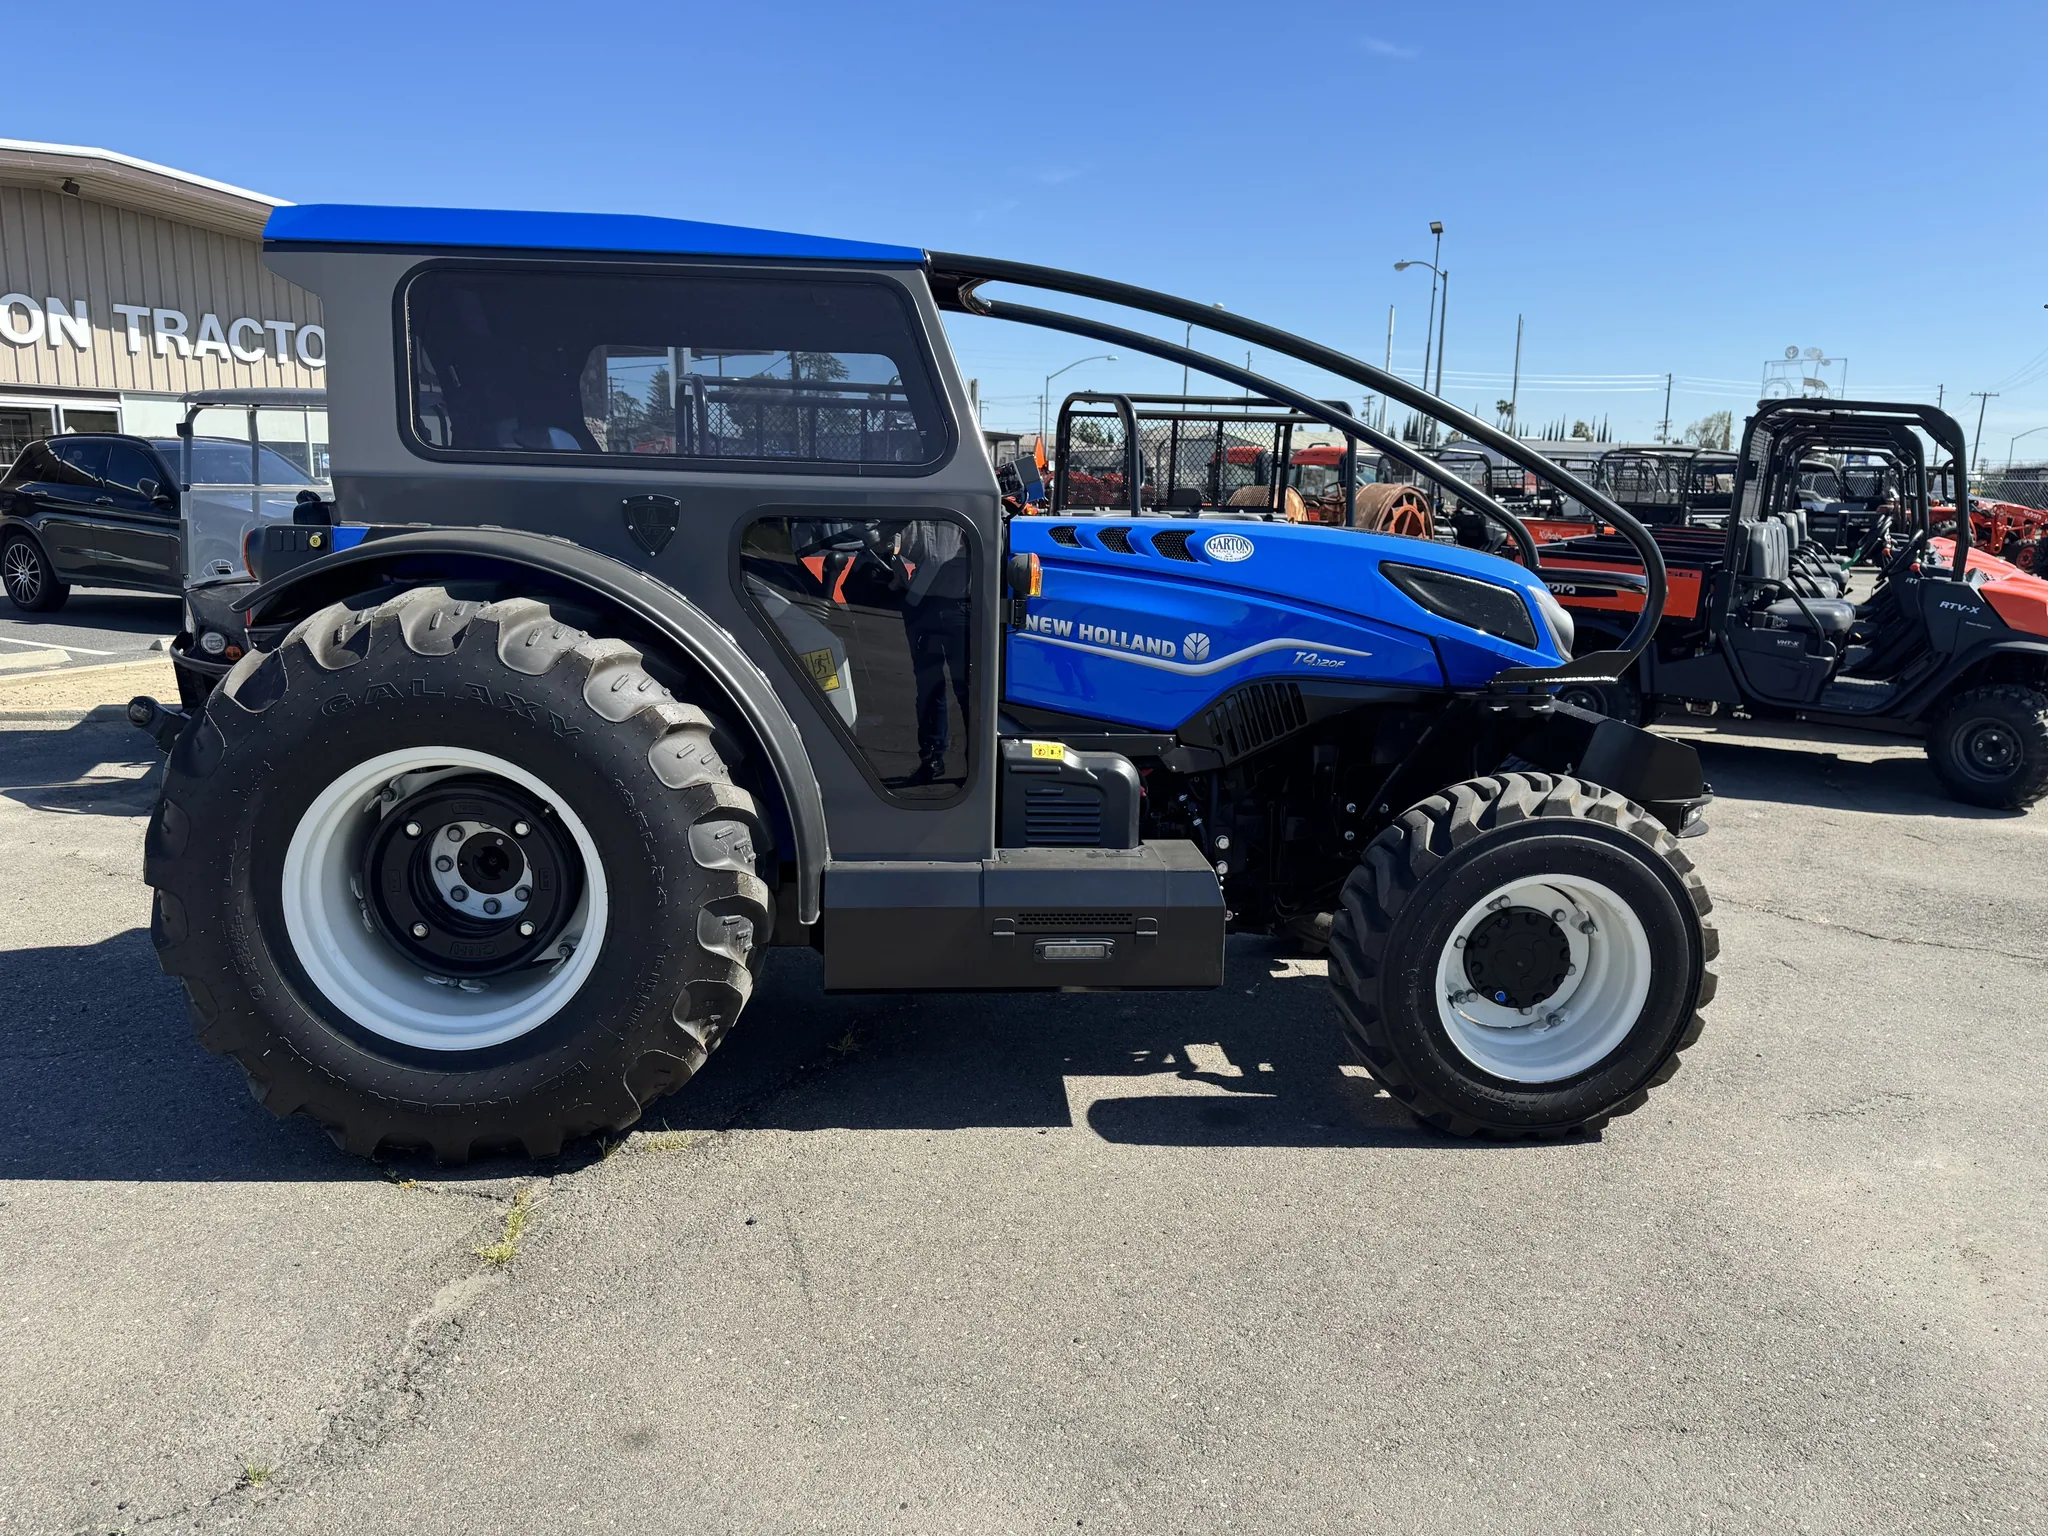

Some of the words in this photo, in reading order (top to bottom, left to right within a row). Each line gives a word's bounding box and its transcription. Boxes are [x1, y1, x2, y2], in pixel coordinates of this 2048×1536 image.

[0, 293, 91, 349] ON
[113, 303, 326, 368] TRACTO
[1209, 537, 1249, 551] GARTON
[1939, 601, 1980, 614] RTV-X
[1026, 614, 1073, 637] NEW
[1079, 623, 1176, 658] HOLLAND
[1293, 651, 1346, 668] T4.120F
[321, 678, 585, 737] GALAXY
